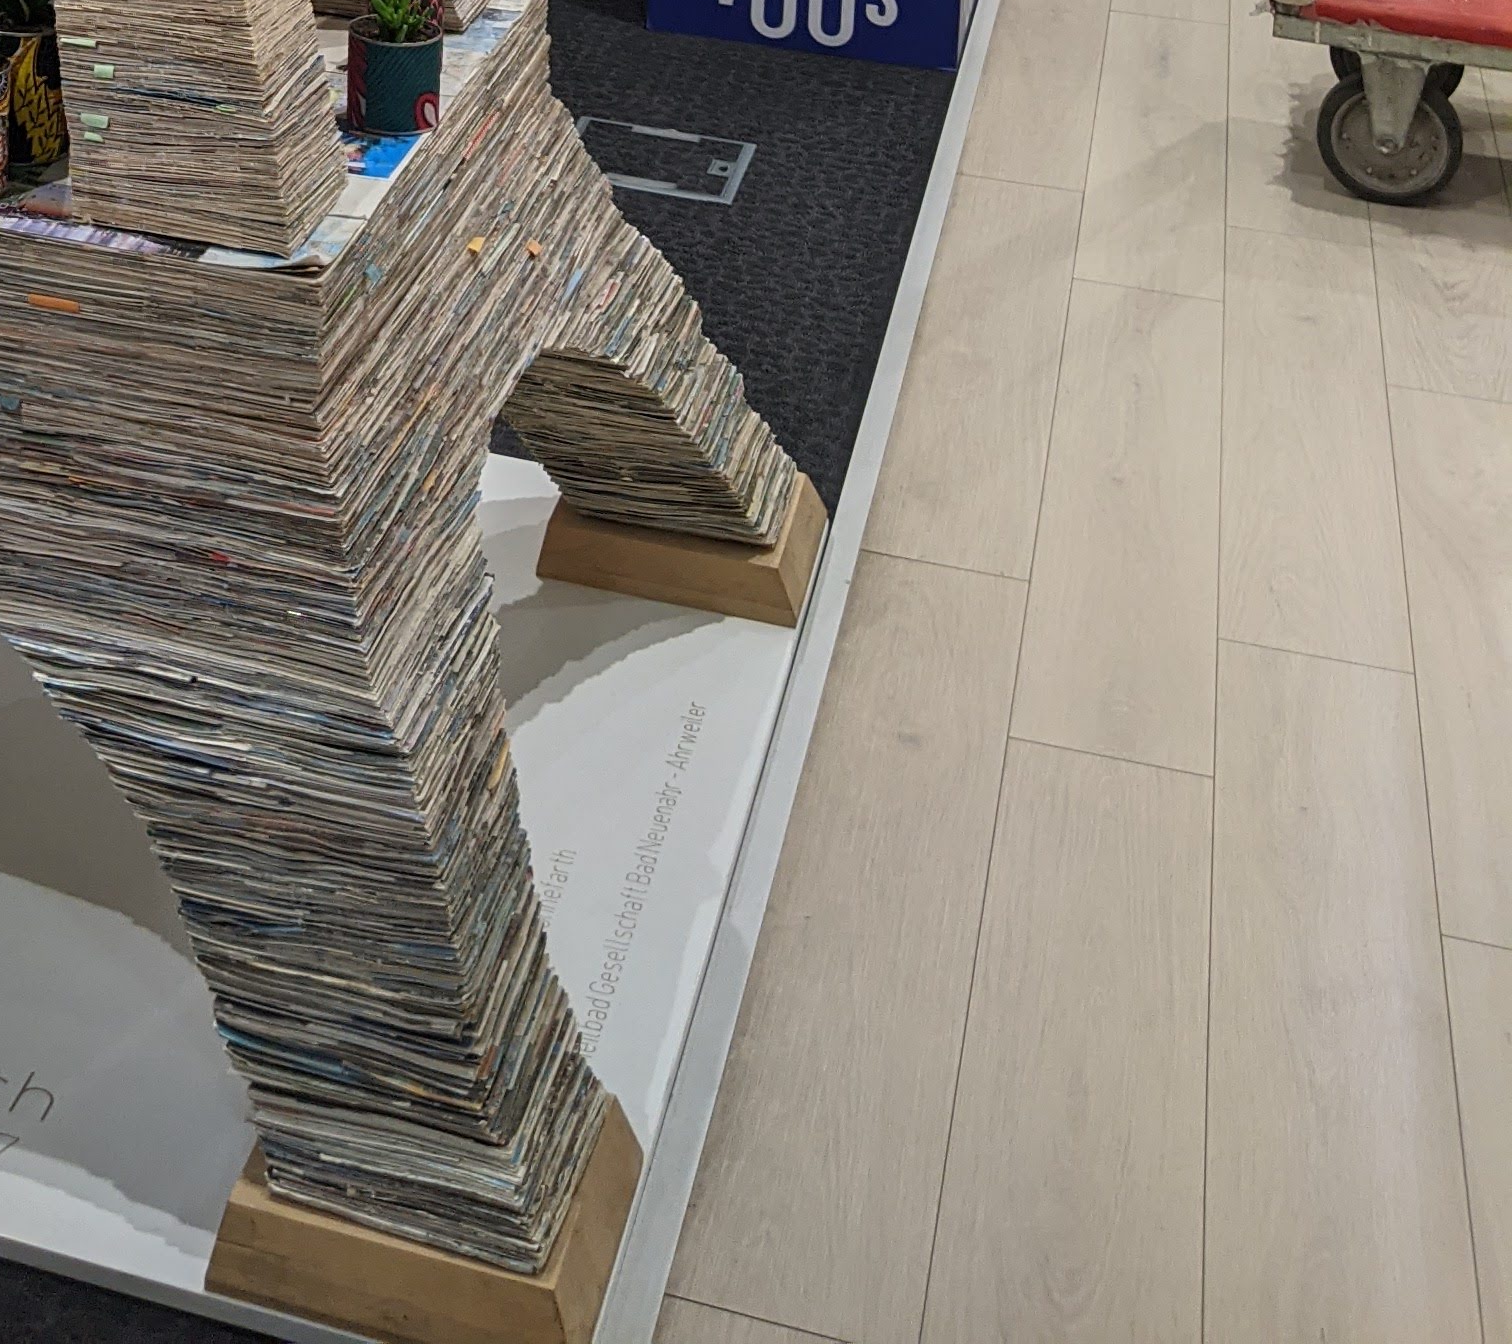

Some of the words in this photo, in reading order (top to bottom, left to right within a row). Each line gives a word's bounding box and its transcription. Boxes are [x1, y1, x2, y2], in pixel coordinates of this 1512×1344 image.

[665, 700, 707, 772] Ahrweiler
[638, 782, 683, 854] Neuenahr
[625, 851, 657, 886] Bad
[589, 885, 649, 995] Gesellschaft
[578, 996, 611, 1058] eilbad
